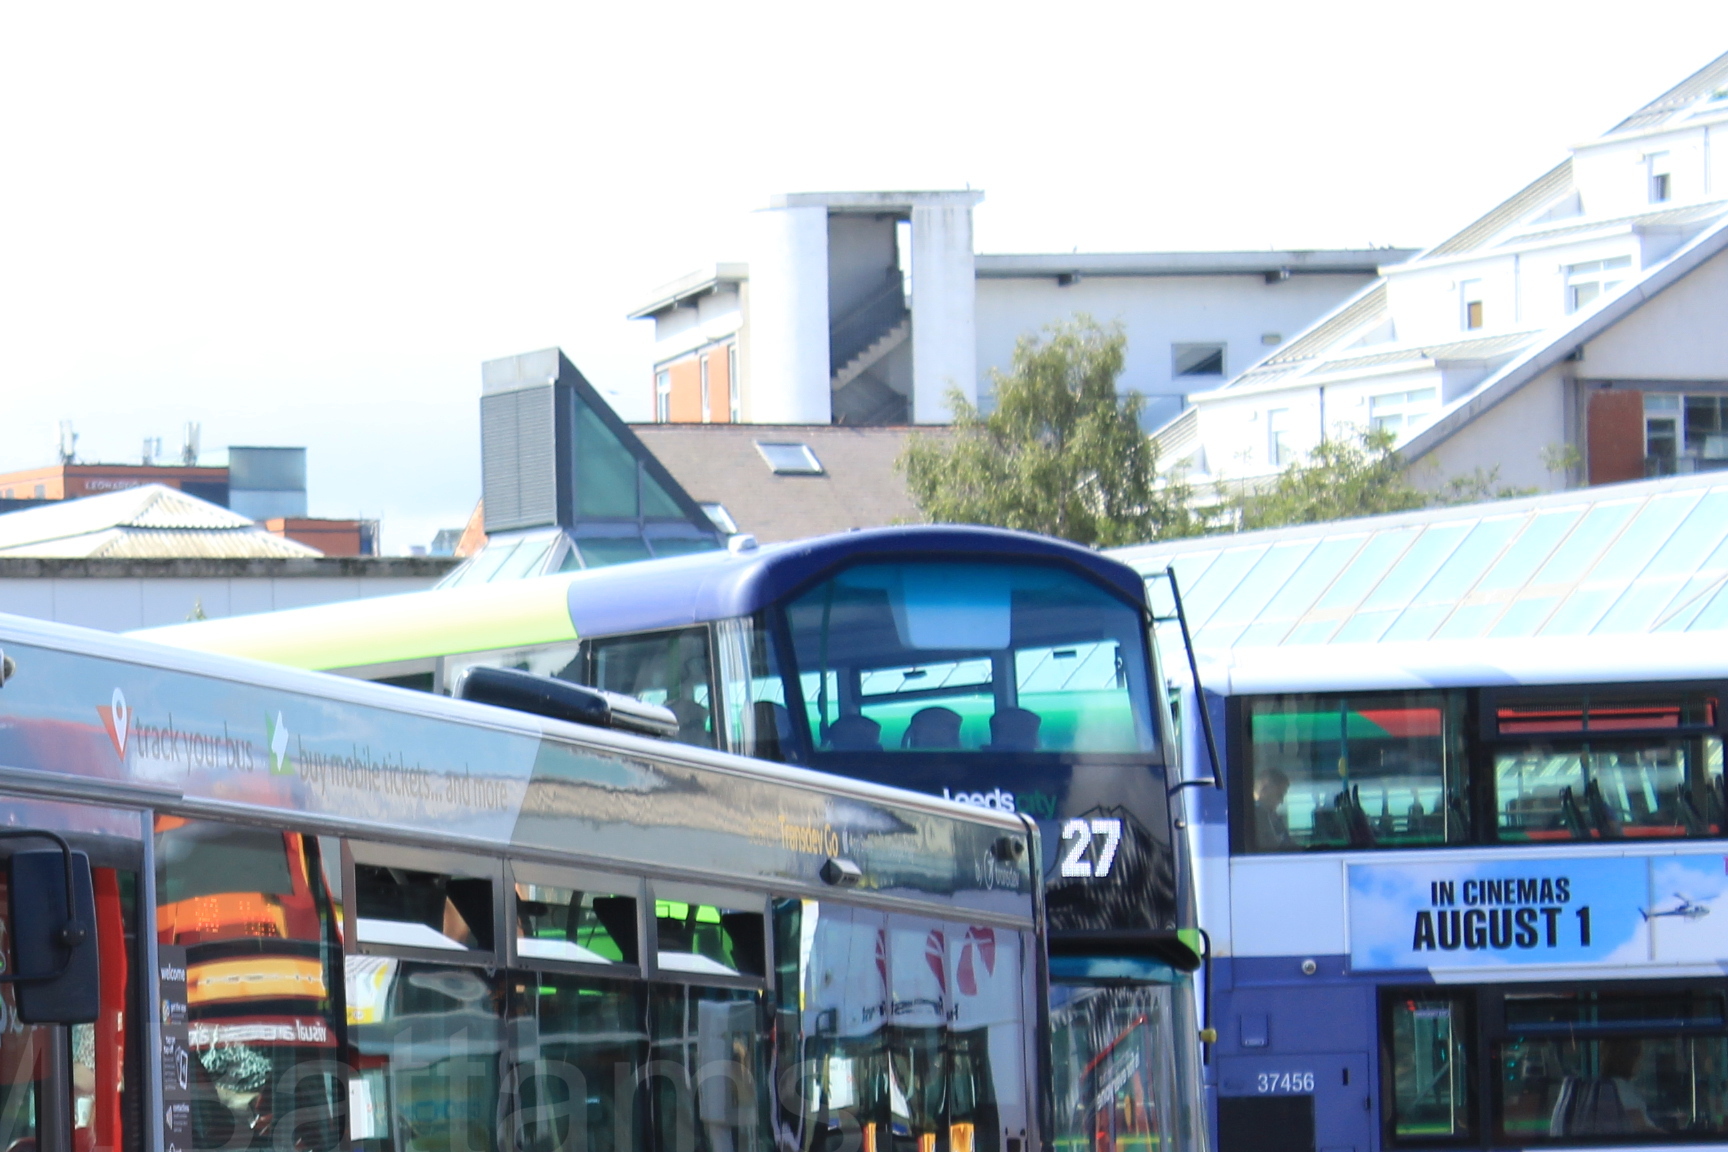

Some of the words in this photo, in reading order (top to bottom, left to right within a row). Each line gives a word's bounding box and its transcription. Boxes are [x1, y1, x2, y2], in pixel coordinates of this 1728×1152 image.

[134, 712, 180, 762] track
[182, 730, 223, 776] your
[223, 720, 254, 773] bus
[297, 733, 327, 796] buy
[330, 743, 381, 793] mobile
[445, 763, 471, 806] and
[472, 776, 509, 812] more
[1016, 789, 1057, 819] city
[778, 814, 823, 856] Transdev
[1061, 818, 1121, 878] 27
[1431, 881, 1455, 906] IN
[1462, 877, 1571, 906] CINEMAS
[1412, 906, 1562, 951] AUGUST
[1575, 905, 1591, 947] 1
[160, 963, 186, 982] welcome
[1257, 1072, 1315, 1092] 37456
